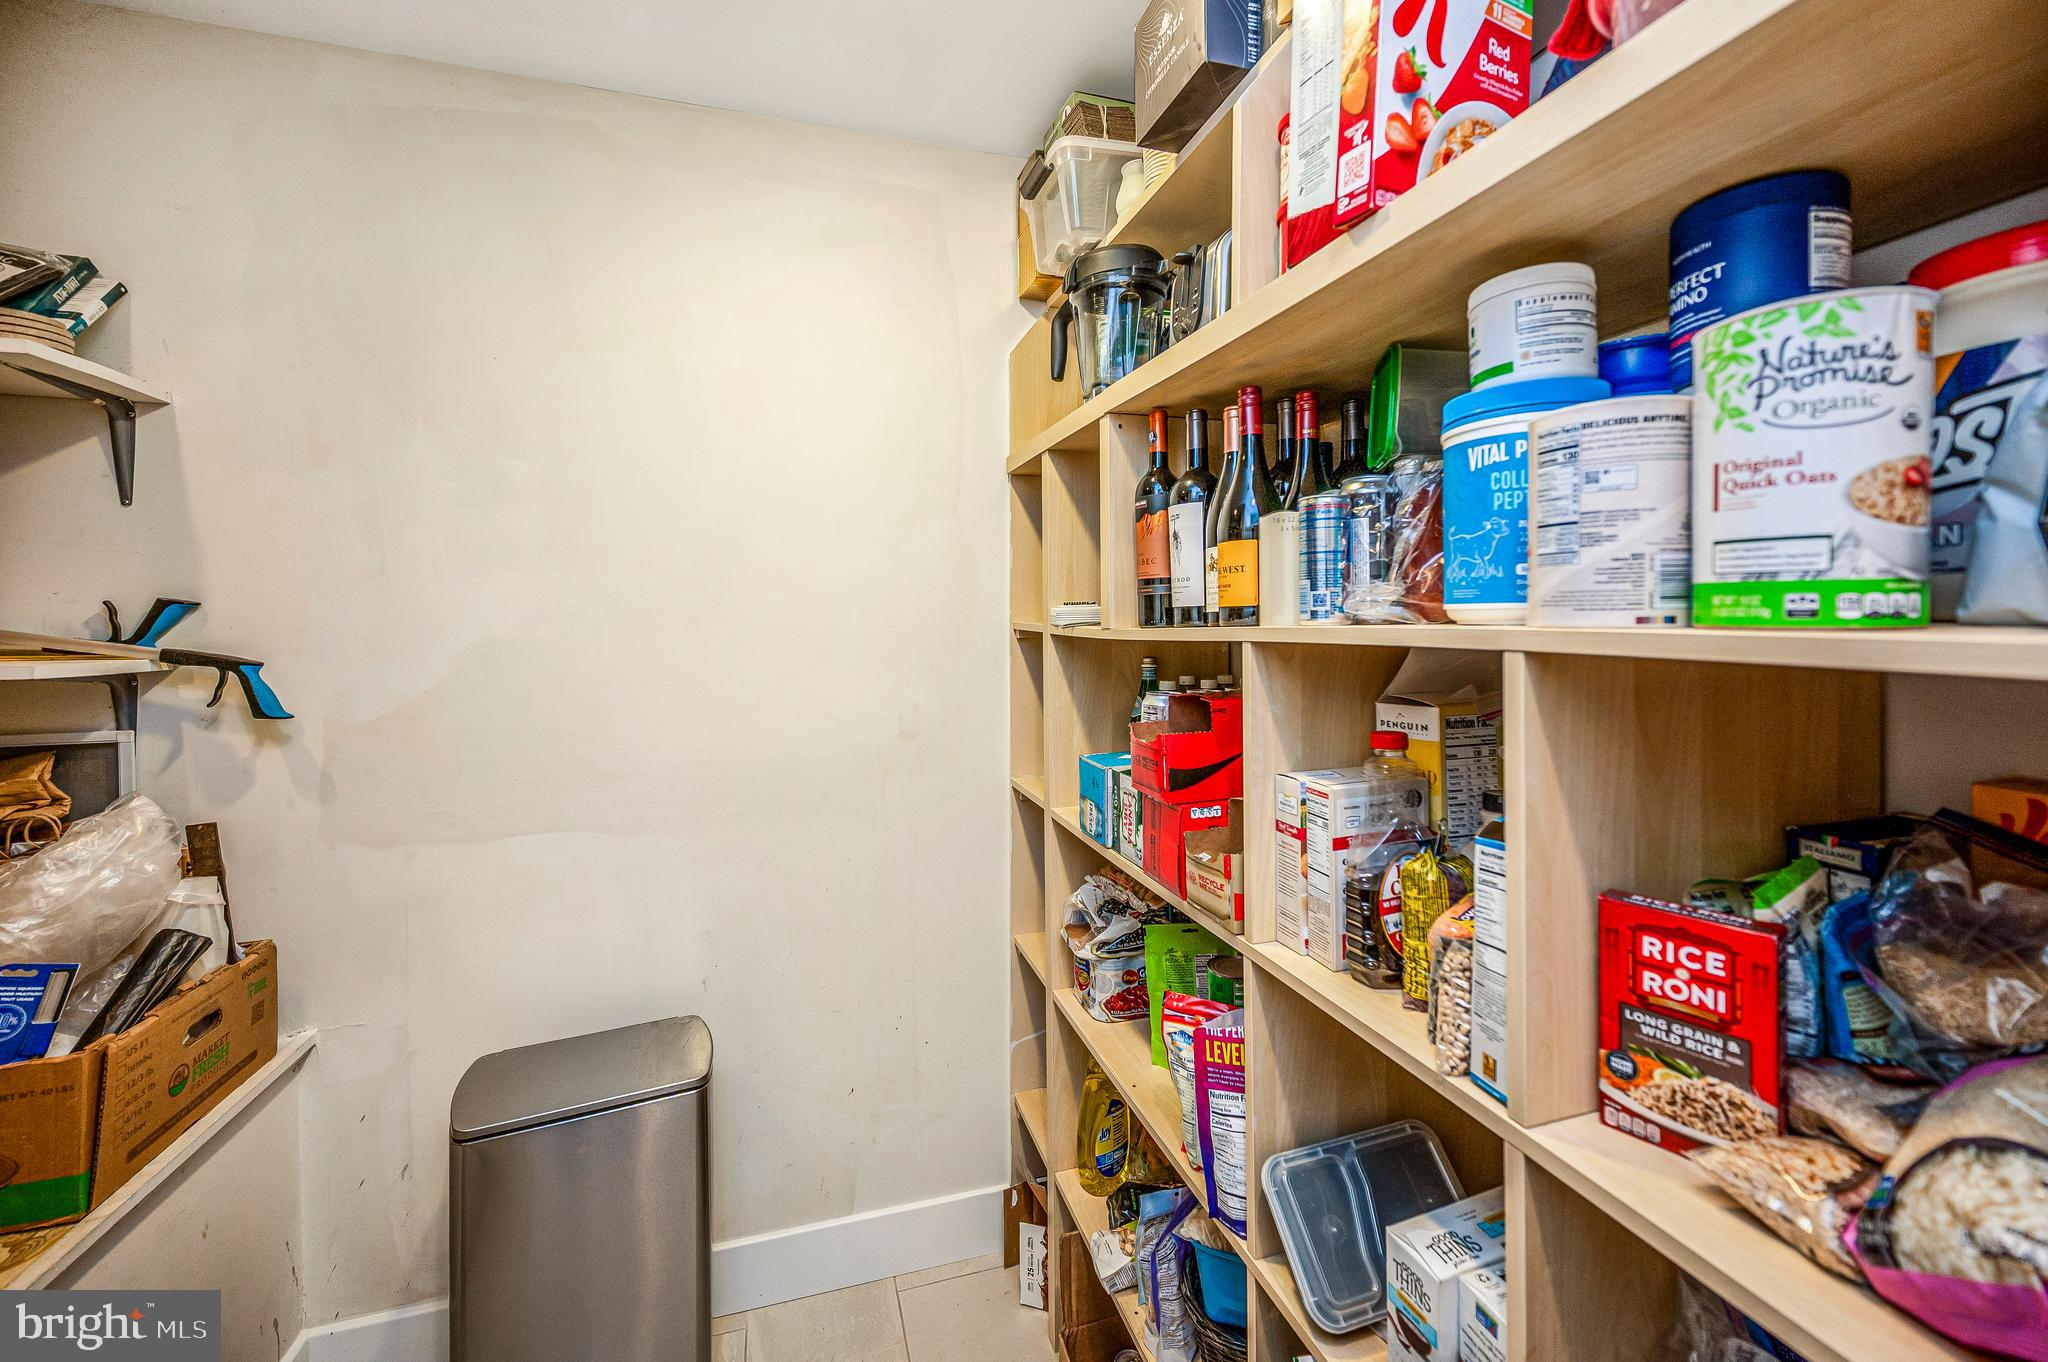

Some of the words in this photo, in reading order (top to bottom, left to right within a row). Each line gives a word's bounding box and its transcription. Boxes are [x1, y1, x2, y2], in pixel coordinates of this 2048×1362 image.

[1149, 11, 1184, 66] ESSENZA
[1170, 37, 1189, 65] CANDLE
[1488, 37, 1510, 62] Red
[1479, 53, 1519, 84] Berries
[1760, 335, 1902, 374] Nature's
[1747, 365, 1914, 411] Promise
[1771, 391, 1882, 420] Organic
[1467, 442, 1509, 472] VITAL
[1722, 451, 1803, 475] Original
[1491, 470, 1529, 490] COLL
[1722, 472, 1778, 494] Quick
[1785, 468, 1838, 487] Oats
[1380, 719, 1429, 732] PENGUIN
[1446, 717, 1476, 729] Nutrition
[1126, 790, 1134, 845] CANADA
[1197, 873, 1225, 892] RECYCLE
[1641, 934, 1727, 978] RICE
[1641, 969, 1727, 1014] RONI
[1624, 1007, 1668, 1030] LONG
[1670, 1020, 1723, 1048] GRAIN
[1726, 1036, 1741, 1055] &
[1640, 1023, 1682, 1046] WILD
[1684, 1036, 1724, 1060] RICE
[126, 1052, 153, 1073] Jumbo
[191, 1032, 231, 1067] MARKET
[191, 1040, 230, 1083] FRESH
[190, 1059, 230, 1093] PRODUCE
[1209, 1090, 1239, 1102] Nutrition
[124, 1121, 147, 1142] Other
[1211, 1118, 1233, 1129] Calories
[1426, 1234, 1483, 1265] THINS
[1431, 1230, 1460, 1245] GOOD
[1027, 1267, 1035, 1278] 25
[1393, 1257, 1432, 1313] THINS
[1400, 1261, 1425, 1289] GOOD
